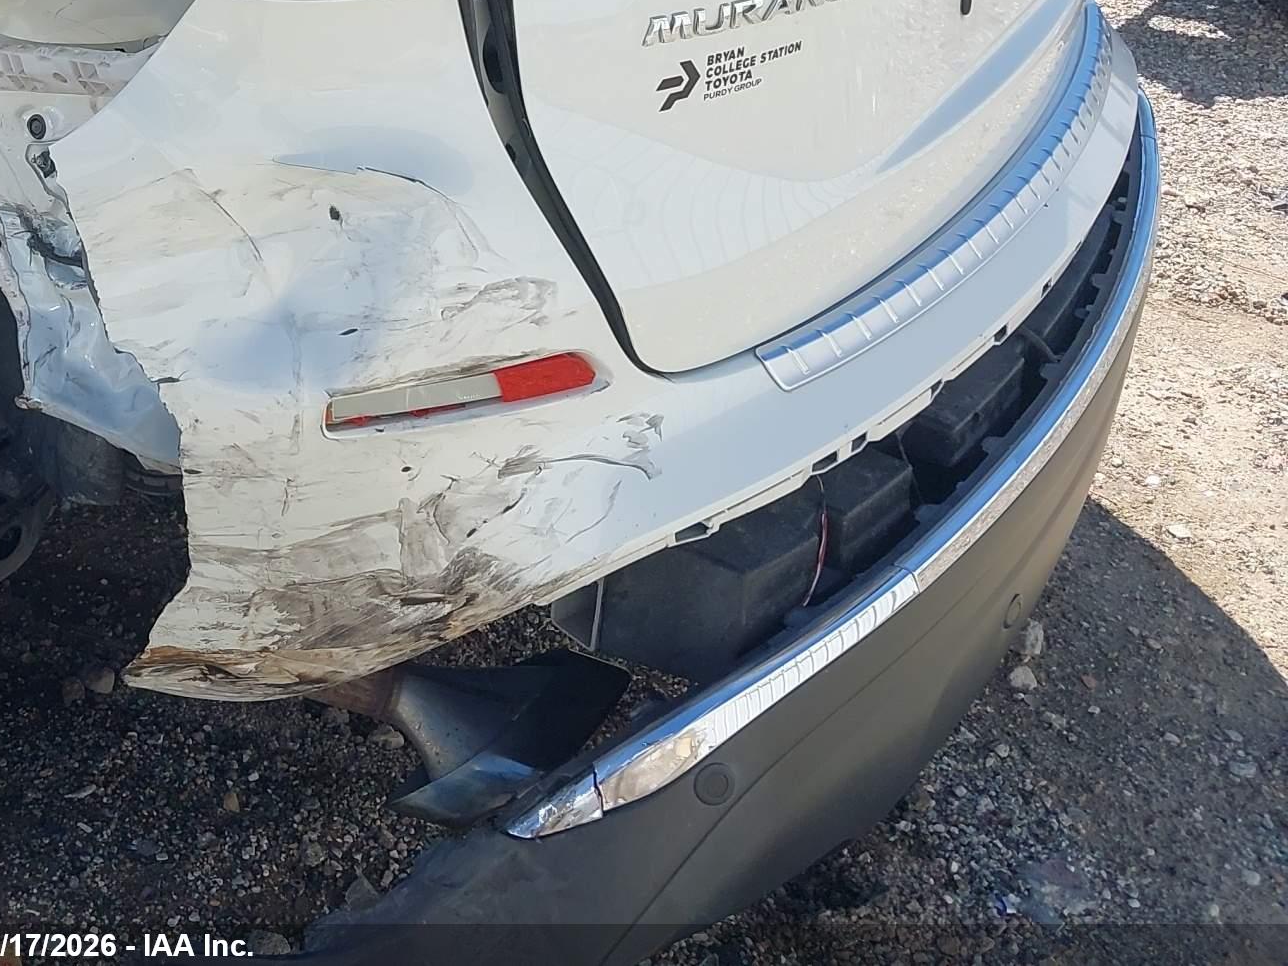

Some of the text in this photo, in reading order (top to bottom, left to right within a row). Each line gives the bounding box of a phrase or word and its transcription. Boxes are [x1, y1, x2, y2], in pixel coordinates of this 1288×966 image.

[705, 40, 803, 78] COLLEGE STATION
[706, 46, 745, 67] BRYAN
[703, 78, 763, 101] PURDY GROUP
[704, 69, 753, 92] TOYOTA
